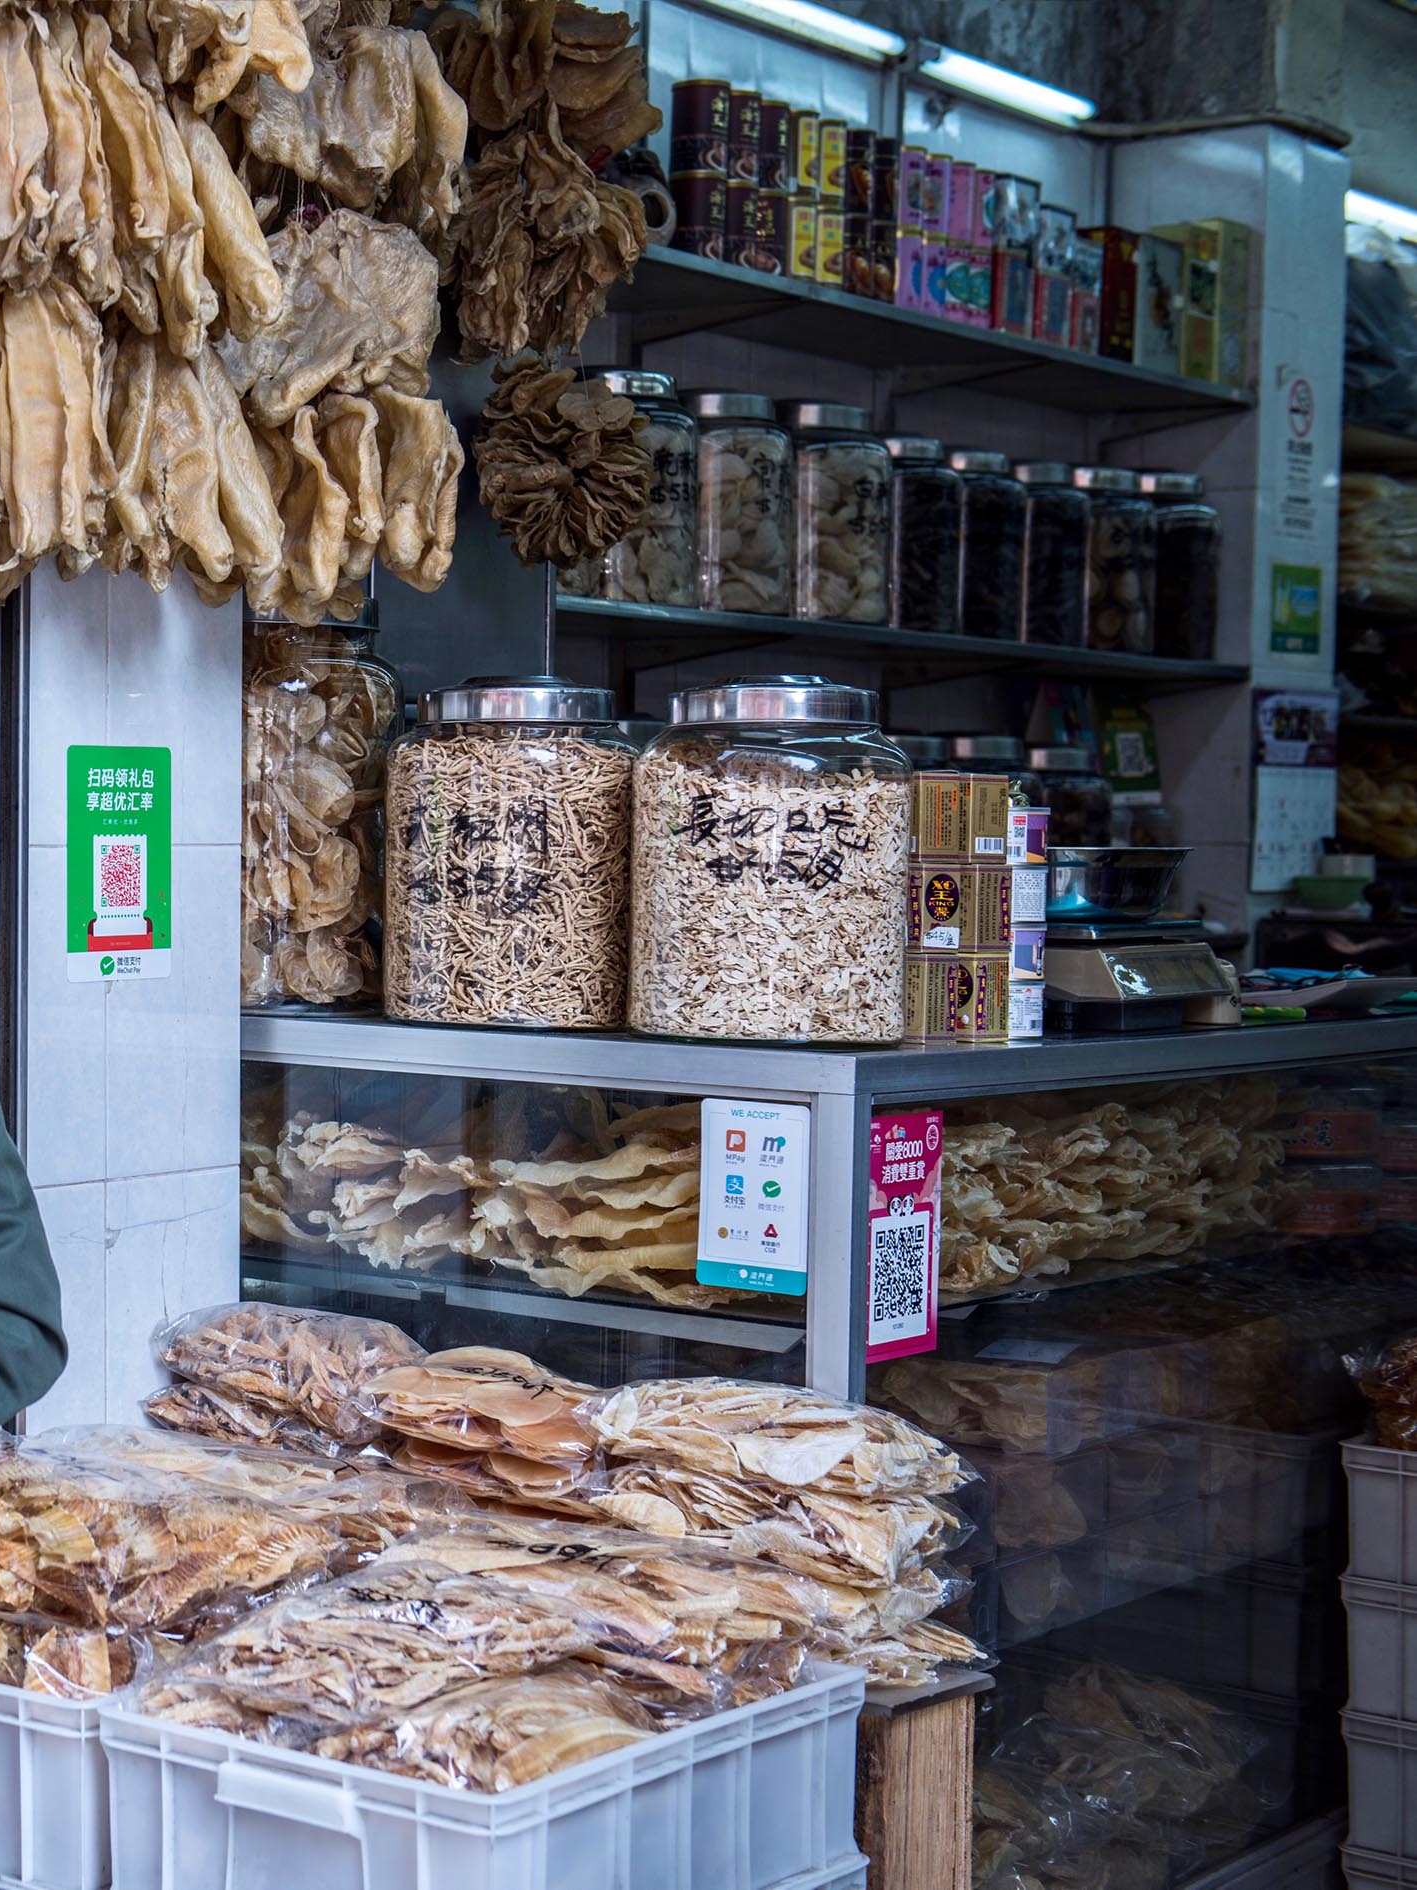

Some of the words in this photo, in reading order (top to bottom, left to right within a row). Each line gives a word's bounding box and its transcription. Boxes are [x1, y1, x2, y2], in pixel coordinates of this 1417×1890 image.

[87, 767, 154, 788] 扫码领礼包
[86, 791, 153, 811] 享超优汇率
[932, 879, 955, 890] XO
[929, 890, 954, 901] 王
[117, 956, 141, 966] 微信支付
[117, 966, 133, 974] WeChat
[730, 1108, 745, 1117] WE
[746, 1110, 781, 1120] ACCEPT
[885, 1140, 923, 1162] 關愛8000
[726, 1154, 746, 1164] MPay
[881, 1160, 926, 1185] 消費雙重賞
[724, 1195, 746, 1206] 支付宝
